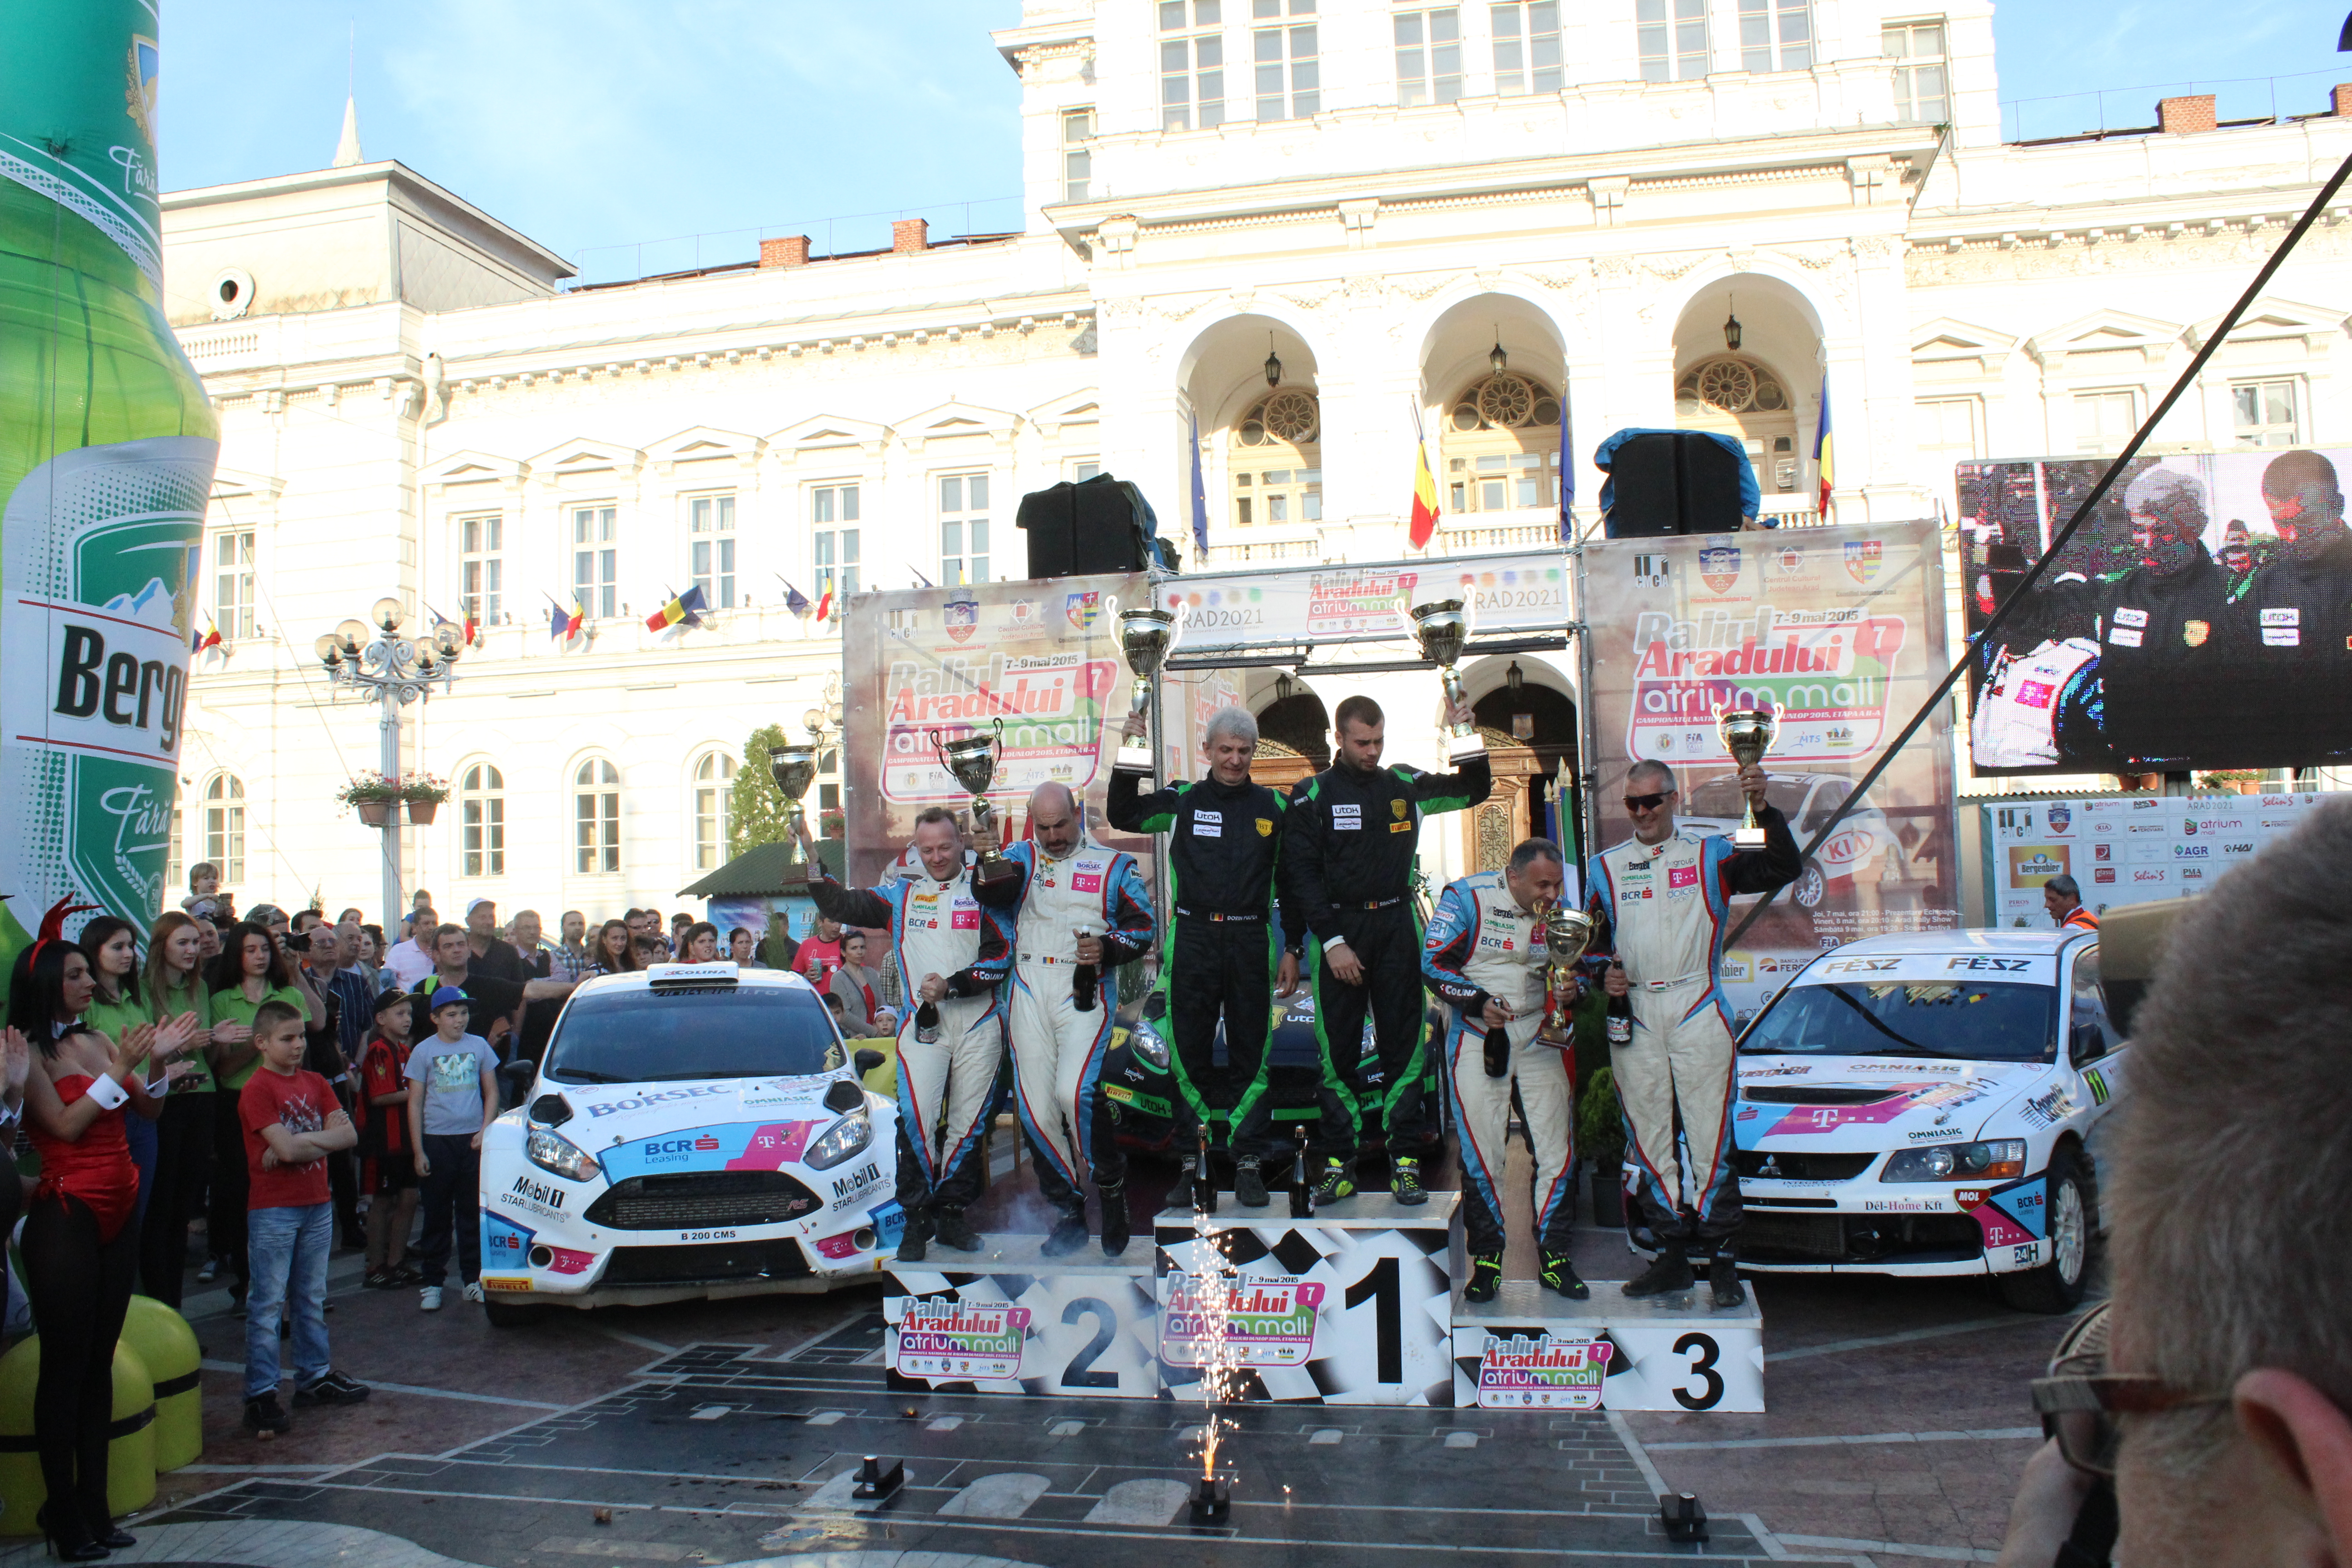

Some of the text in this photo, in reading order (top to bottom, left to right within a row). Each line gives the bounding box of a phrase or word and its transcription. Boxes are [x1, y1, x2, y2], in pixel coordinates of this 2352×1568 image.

[1309, 569, 1364, 588] Raliul
[1310, 579, 1393, 600] Aradului
[1312, 600, 1367, 614] atrium
[1775, 610, 1858, 622] 7 9 mai 2015
[1637, 609, 1773, 650] Raliul
[1874, 626, 1886, 648] 7
[1006, 655, 1078, 669] 7 9 mai 2015
[1637, 635, 1842, 677] Aradului
[889, 654, 1003, 696] Raliul
[1090, 669, 1103, 690] 7
[889, 678, 1064, 721] Aradului
[1644, 677, 1872, 712] atrium mall
[1015, 715, 1090, 746] mall
[1800, 735, 1820, 743] MTS
[1007, 750, 1035, 759] DUNLOP
[2200, 819, 2242, 829] atrium
[2185, 846, 2209, 855] AGR
[2022, 864, 2060, 873] Bergenbier
[1621, 891, 1640, 901] BCR
[1667, 887, 1695, 899] dolce
[909, 918, 926, 927] BCR
[1484, 919, 1515, 930] OMNIASIG
[1481, 936, 1501, 948] BCR
[1126, 1068, 1144, 1080] LeasePlan
[1850, 1064, 1961, 1072] OMNIASIG
[744, 1095, 814, 1105] OMNIASIG
[1107, 1087, 1132, 1099] PIRELLI
[587, 1085, 729, 1117] BORSEC
[1908, 1127, 1962, 1139] OMNIASIG
[645, 1138, 692, 1156] BCR
[646, 1154, 689, 1164] Leasing
[512, 1176, 550, 1203] Mobil
[832, 1167, 868, 1198] Mobil
[1958, 1191, 1980, 1201] MOL
[2017, 1197, 2034, 1209] BCR
[788, 1199, 809, 1210] RS
[1865, 1200, 1943, 1210] Dél-Home Kft
[691, 1231, 710, 1240] 200
[714, 1230, 736, 1239] CMS
[487, 1279, 529, 1290] PIRELLI
[1306, 1287, 1315, 1301] 7
[901, 1297, 966, 1318] Raliul
[900, 1312, 1001, 1333] Aradului
[1016, 1311, 1023, 1323] 7
[1345, 1257, 1402, 1384] 1
[1255, 1316, 1307, 1335] mall
[904, 1334, 1016, 1352] atrium mall
[1061, 1297, 1119, 1388] 2
[1482, 1335, 1549, 1354] Raliul
[1482, 1349, 1582, 1367] Aradului
[1597, 1346, 1603, 1358] 7
[1485, 1370, 1597, 1384] atrium mall
[1672, 1332, 1725, 1411] 3
